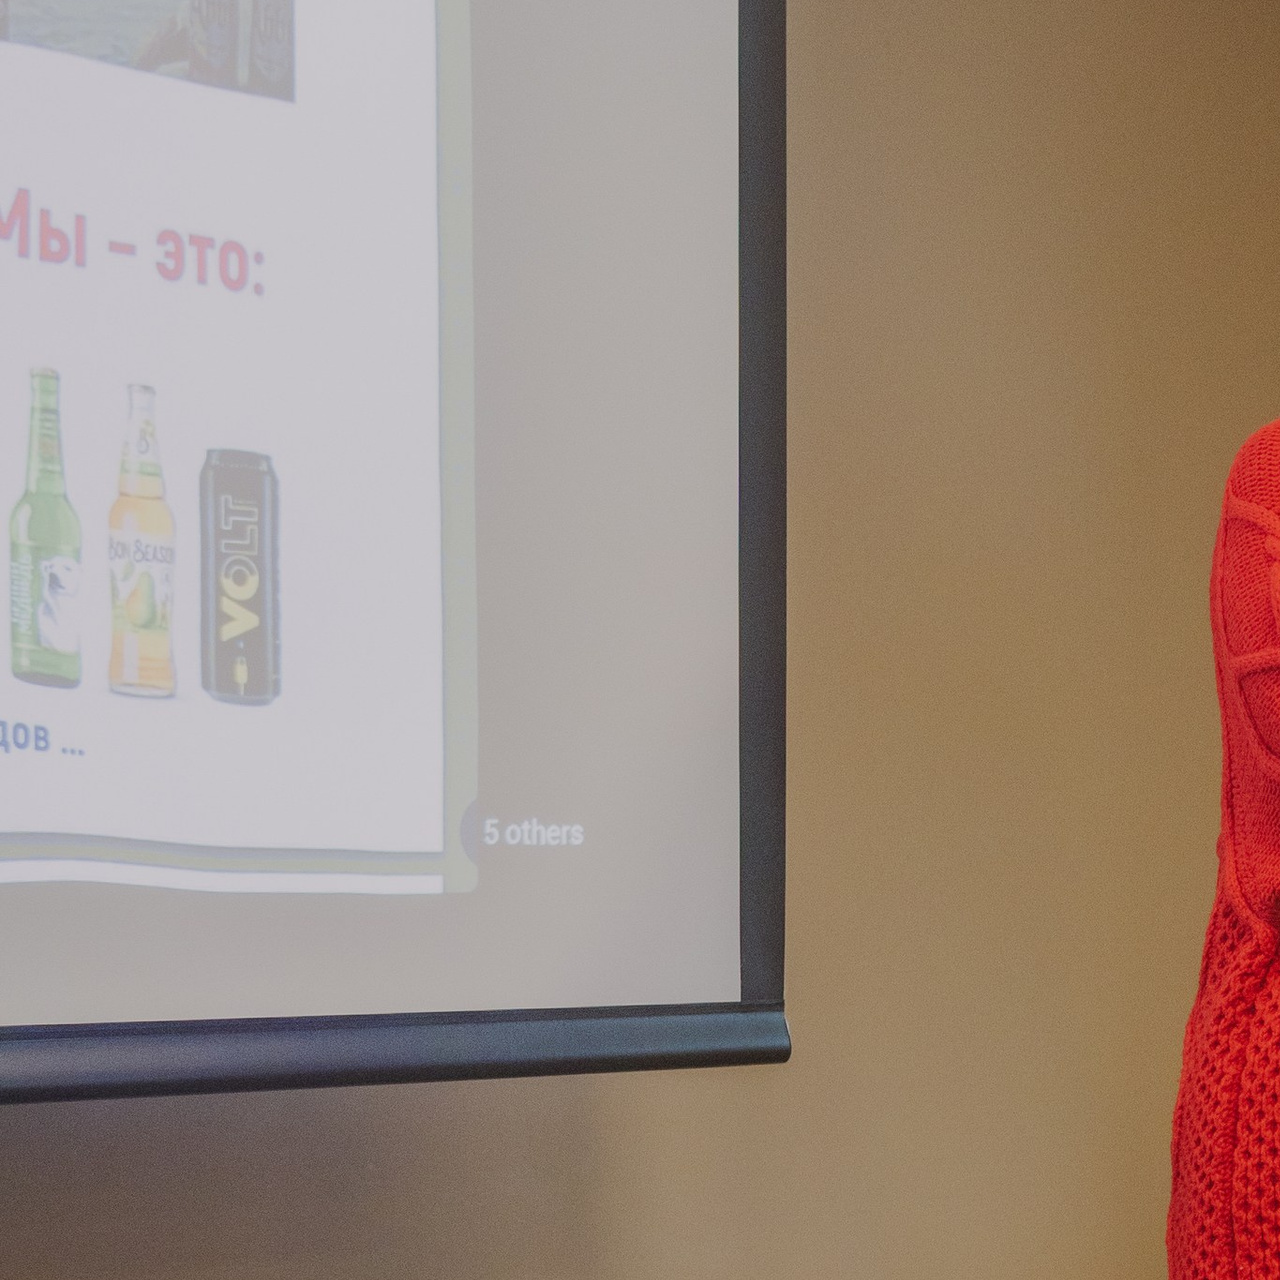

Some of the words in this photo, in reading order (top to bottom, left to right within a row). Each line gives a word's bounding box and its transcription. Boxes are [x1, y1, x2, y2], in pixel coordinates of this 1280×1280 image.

[218, 494, 261, 642] VOLT
[483, 817, 500, 846] 5
[504, 817, 585, 846] others
